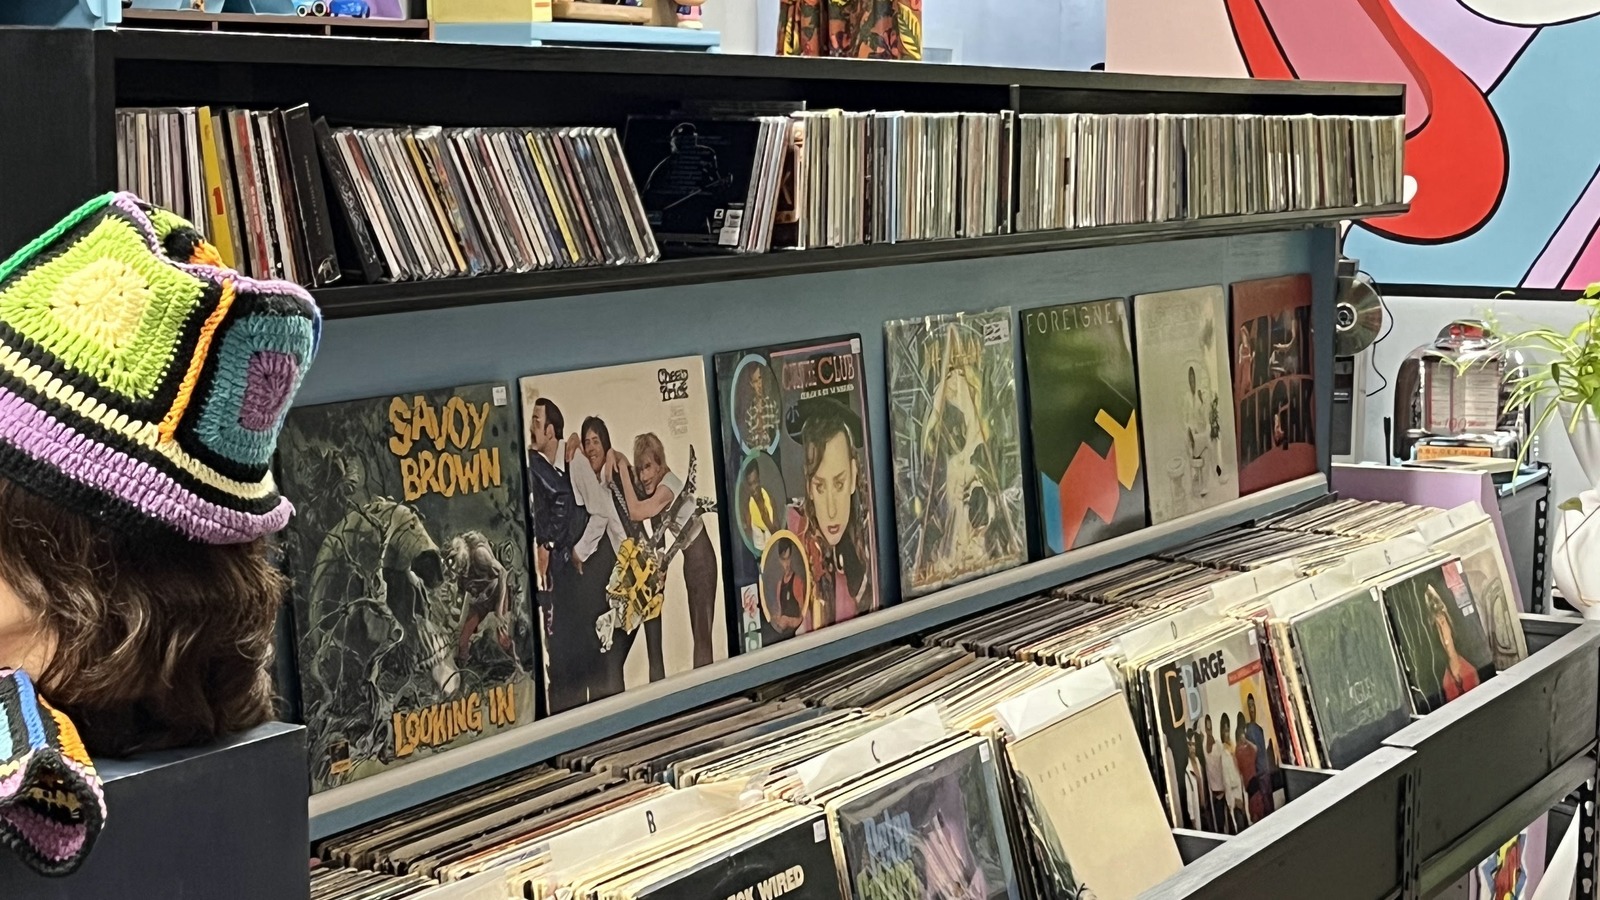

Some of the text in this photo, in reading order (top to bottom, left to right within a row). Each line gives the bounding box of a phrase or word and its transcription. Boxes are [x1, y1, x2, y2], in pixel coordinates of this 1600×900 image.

[818, 353, 855, 384] CLUB
[388, 395, 490, 457] SAVOY
[400, 446, 501, 502] BROWN
[393, 683, 515, 757] LOOKING IN
[645, 810, 657, 834] B
[757, 864, 805, 900] WIRED
